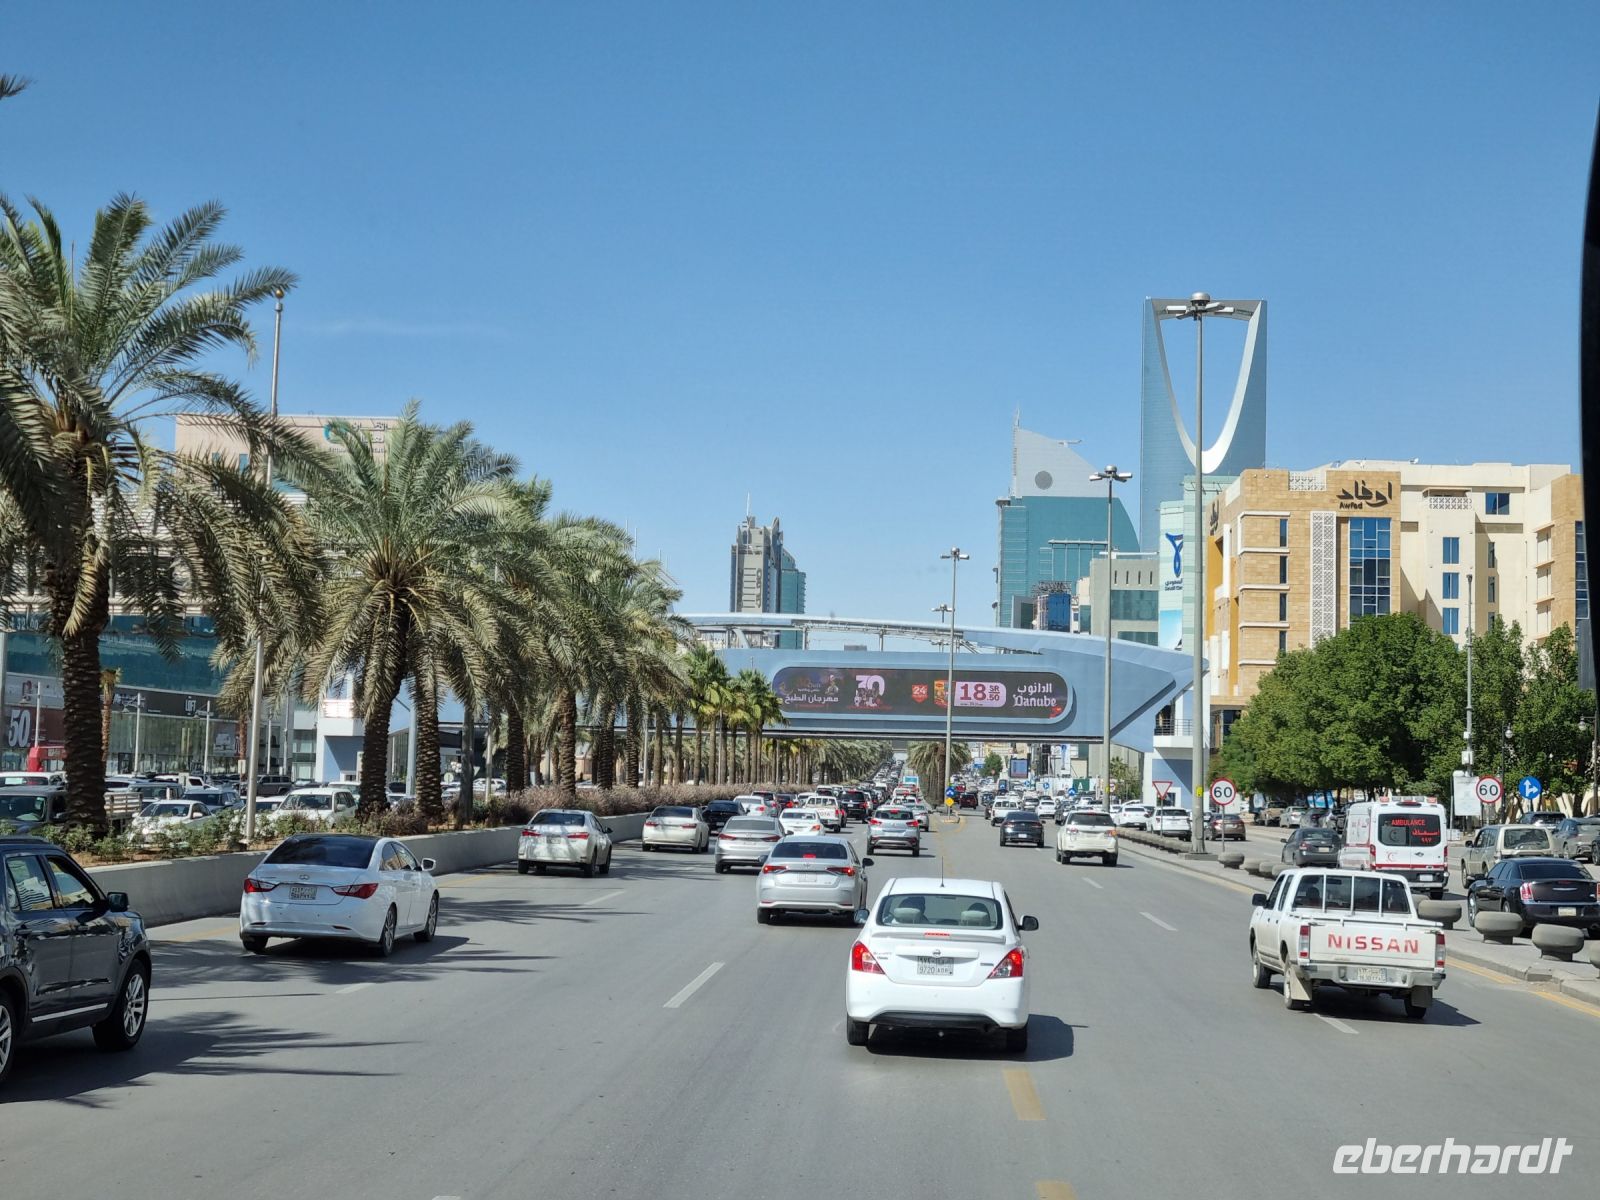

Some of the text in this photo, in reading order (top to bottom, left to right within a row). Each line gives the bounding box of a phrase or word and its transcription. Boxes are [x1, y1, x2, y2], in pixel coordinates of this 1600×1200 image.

[960, 683, 987, 701] 18
[1013, 694, 1058, 708] Danube
[1214, 786, 1232, 798] 60
[1480, 784, 1498, 796] 60
[1328, 934, 1418, 954] NISSAN
